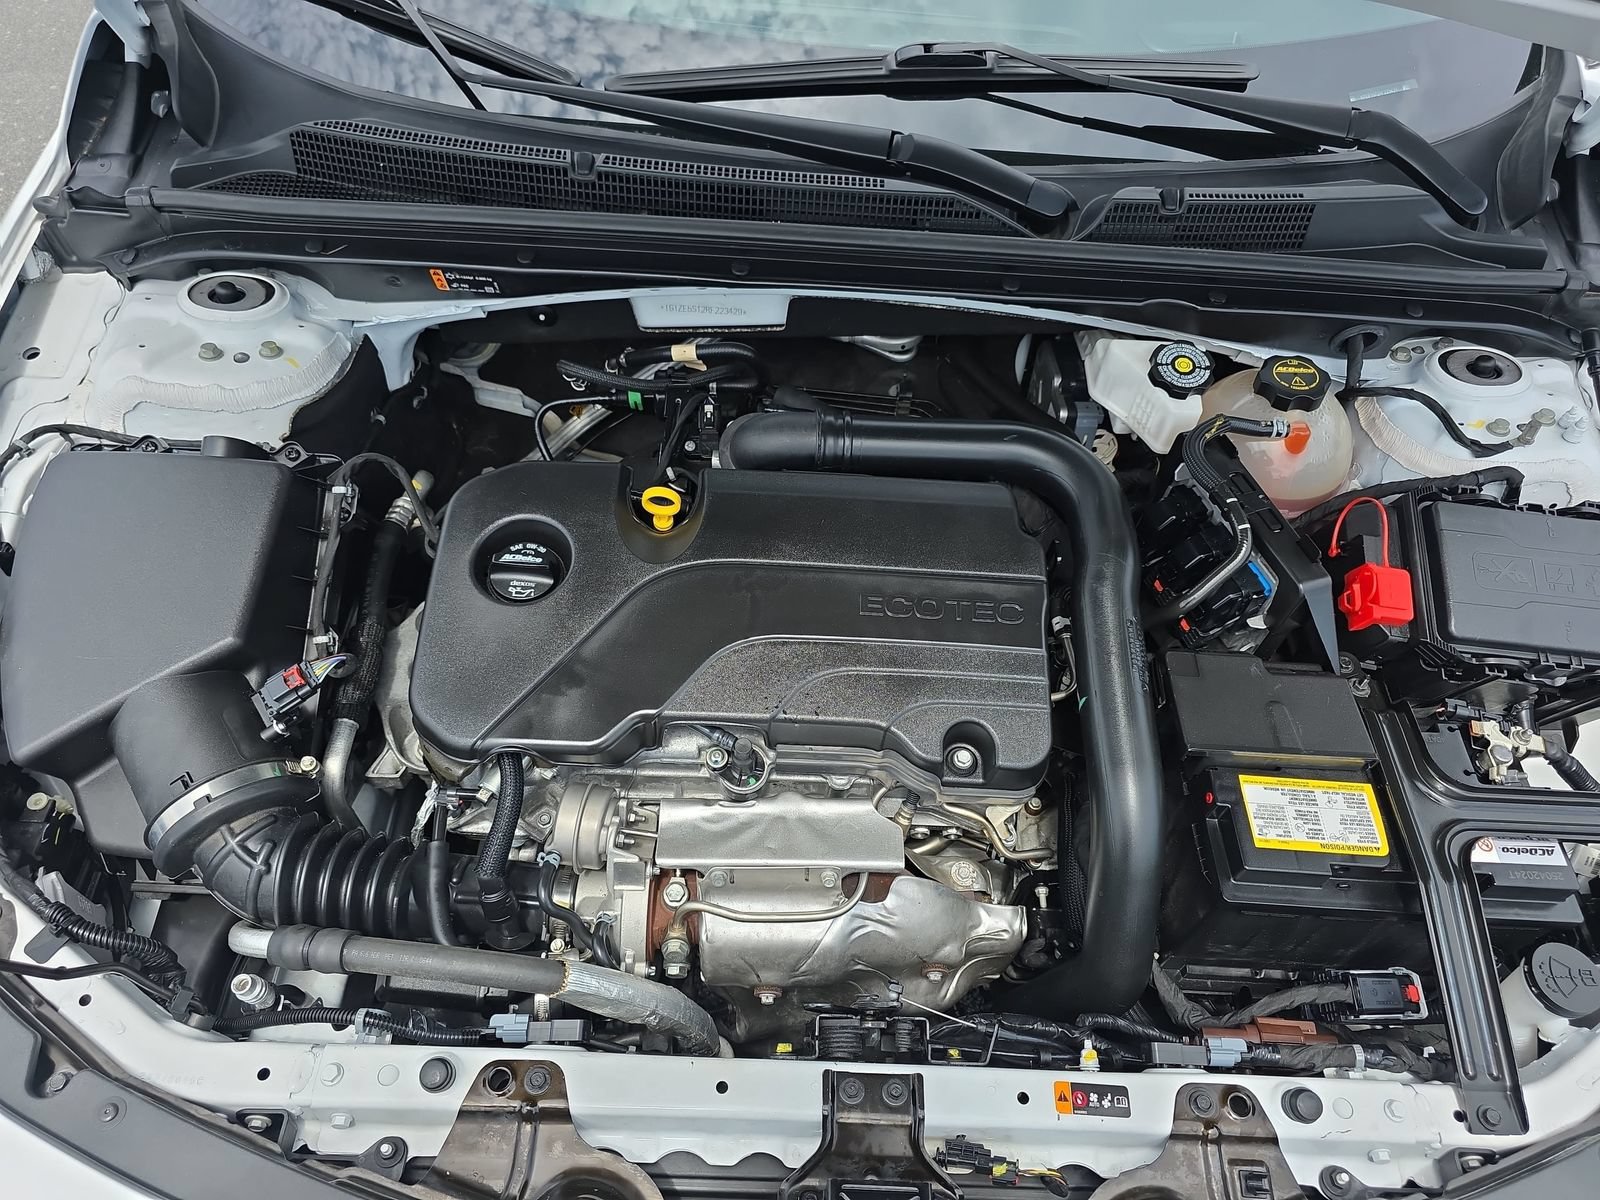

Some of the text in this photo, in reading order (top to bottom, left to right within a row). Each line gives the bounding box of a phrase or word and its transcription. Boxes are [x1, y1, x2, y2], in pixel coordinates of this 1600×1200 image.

[510, 543, 547, 553] SAE 0W-20
[499, 553, 543, 563] ACDelco
[859, 593, 1025, 625] ECOTEC
[1320, 843, 1374, 853] DANGER/POISON
[1501, 847, 1555, 856] ACDelco
